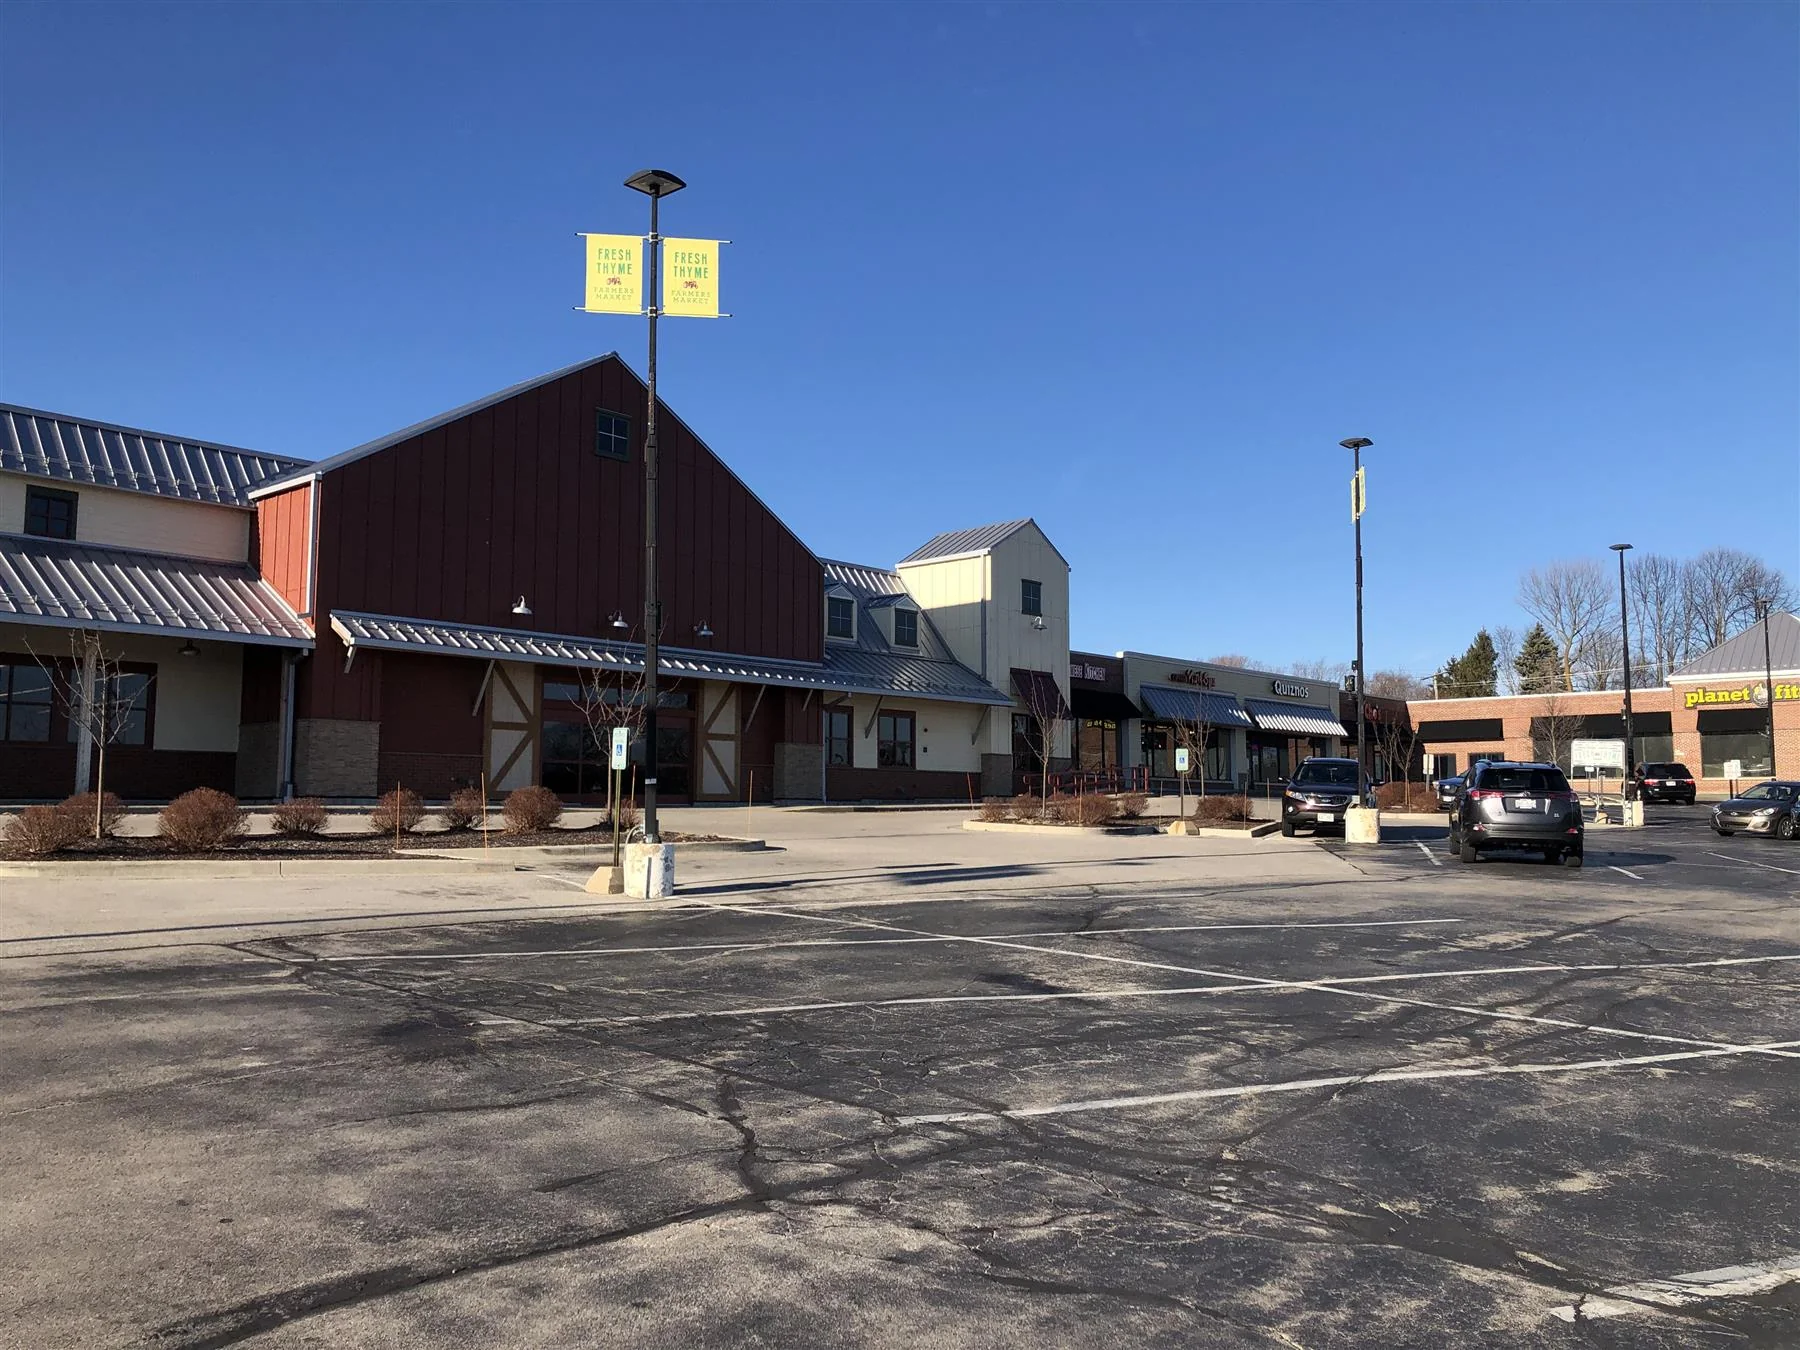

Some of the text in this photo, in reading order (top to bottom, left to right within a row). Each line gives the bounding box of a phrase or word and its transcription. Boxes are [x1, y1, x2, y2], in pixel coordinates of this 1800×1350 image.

[598, 248, 632, 261] FRESH
[674, 251, 708, 265] FRESH
[597, 262, 633, 275] THYME
[673, 265, 709, 279] THYME
[593, 286, 635, 294] FARMERS
[671, 290, 711, 298] FARMERS
[595, 293, 632, 301] MARKET
[673, 296, 709, 304] MARKET
[1685, 684, 1800, 708] planet fit
